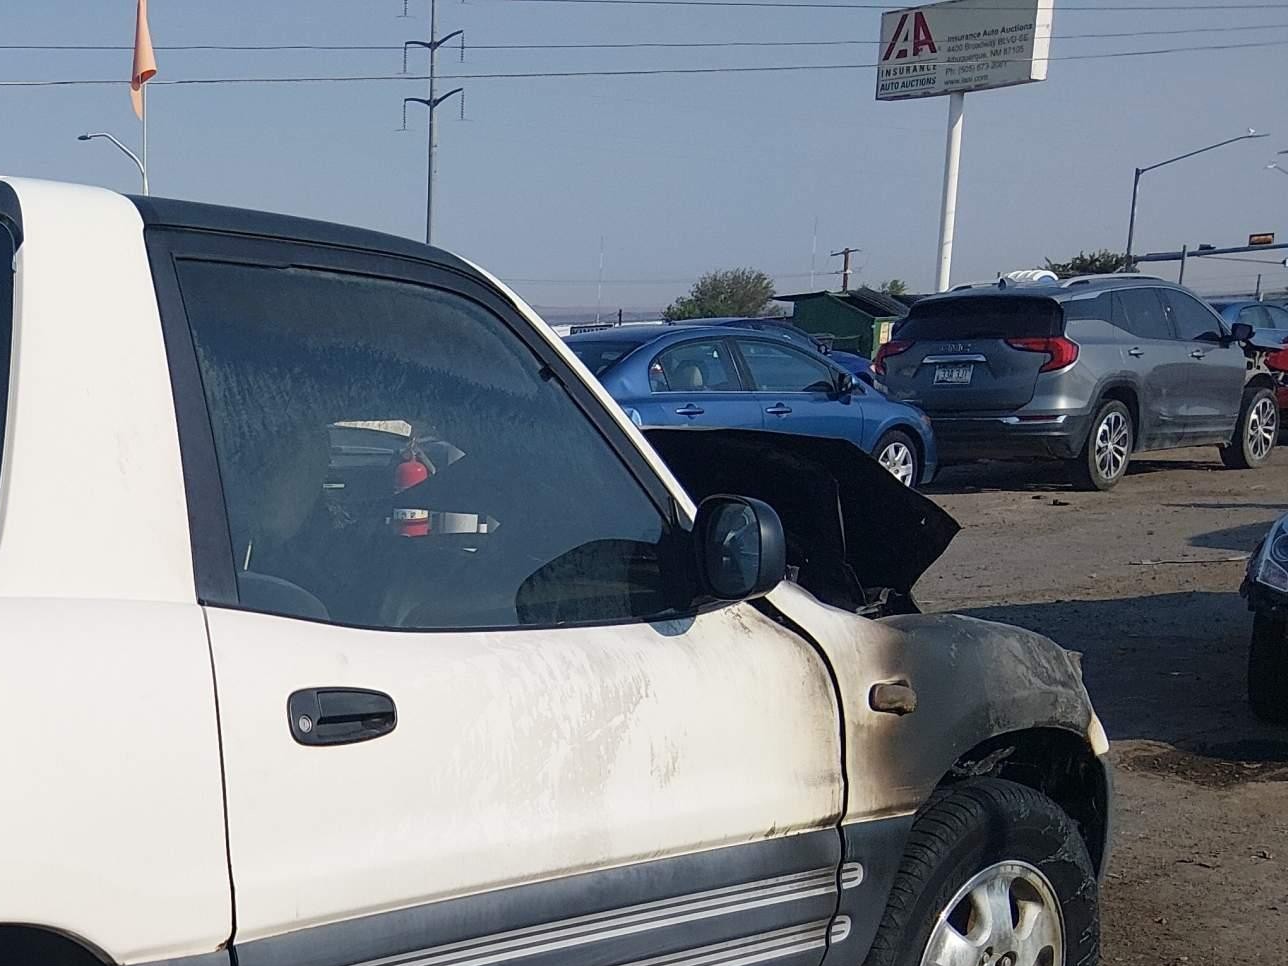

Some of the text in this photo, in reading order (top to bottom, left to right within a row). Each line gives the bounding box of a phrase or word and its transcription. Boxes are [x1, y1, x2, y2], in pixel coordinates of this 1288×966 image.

[947, 24, 1033, 43] Insurance Auto Auctions
[990, 49, 1002, 57] NM
[880, 65, 937, 78] INSURANCE
[879, 77, 937, 92] AUTO AUCTIONS
